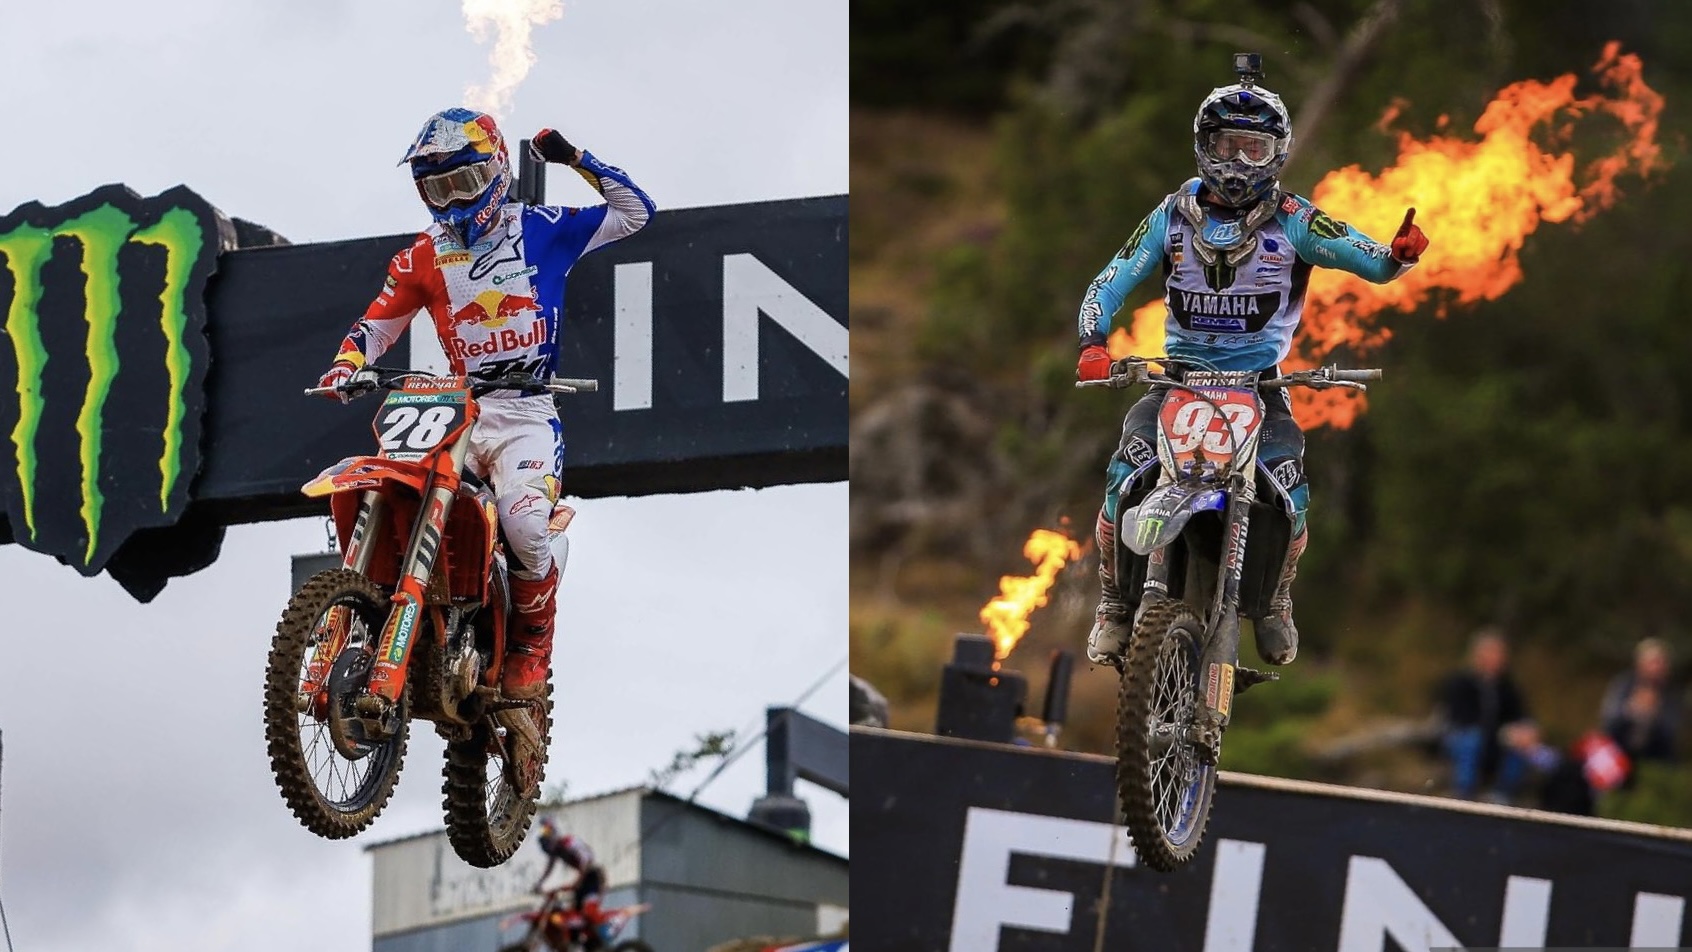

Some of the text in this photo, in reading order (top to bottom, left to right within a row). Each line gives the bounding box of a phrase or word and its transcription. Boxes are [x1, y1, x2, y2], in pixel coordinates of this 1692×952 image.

[1181, 292, 1259, 316] YAMAHA
[410, 253, 848, 412] IN
[453, 332, 498, 359] Red
[500, 319, 546, 352] Bull
[397, 394, 439, 403] MOTOREX
[1194, 390, 1228, 400] MAHA
[380, 406, 456, 449] 28
[1169, 400, 1255, 454] 93
[396, 602, 417, 648] MOTOREX
